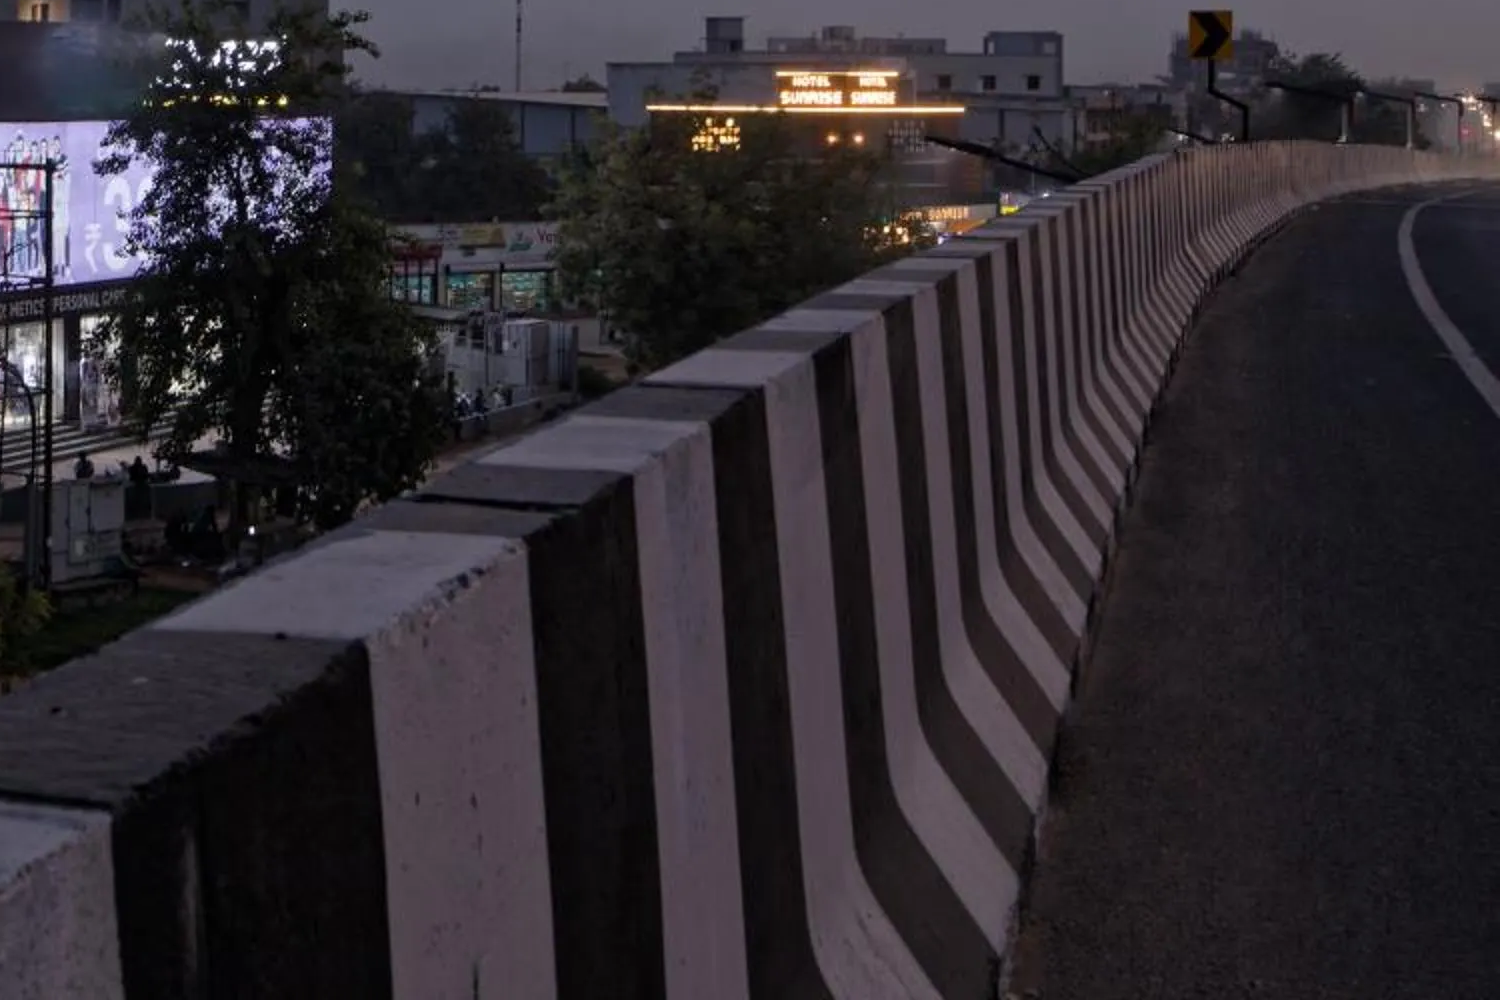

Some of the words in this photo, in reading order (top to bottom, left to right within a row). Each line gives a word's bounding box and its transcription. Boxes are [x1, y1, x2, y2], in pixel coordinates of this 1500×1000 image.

[792, 75, 831, 87] HOTEL
[780, 91, 842, 105] SUNRISE
[52, 290, 101, 314] PERSONAL
